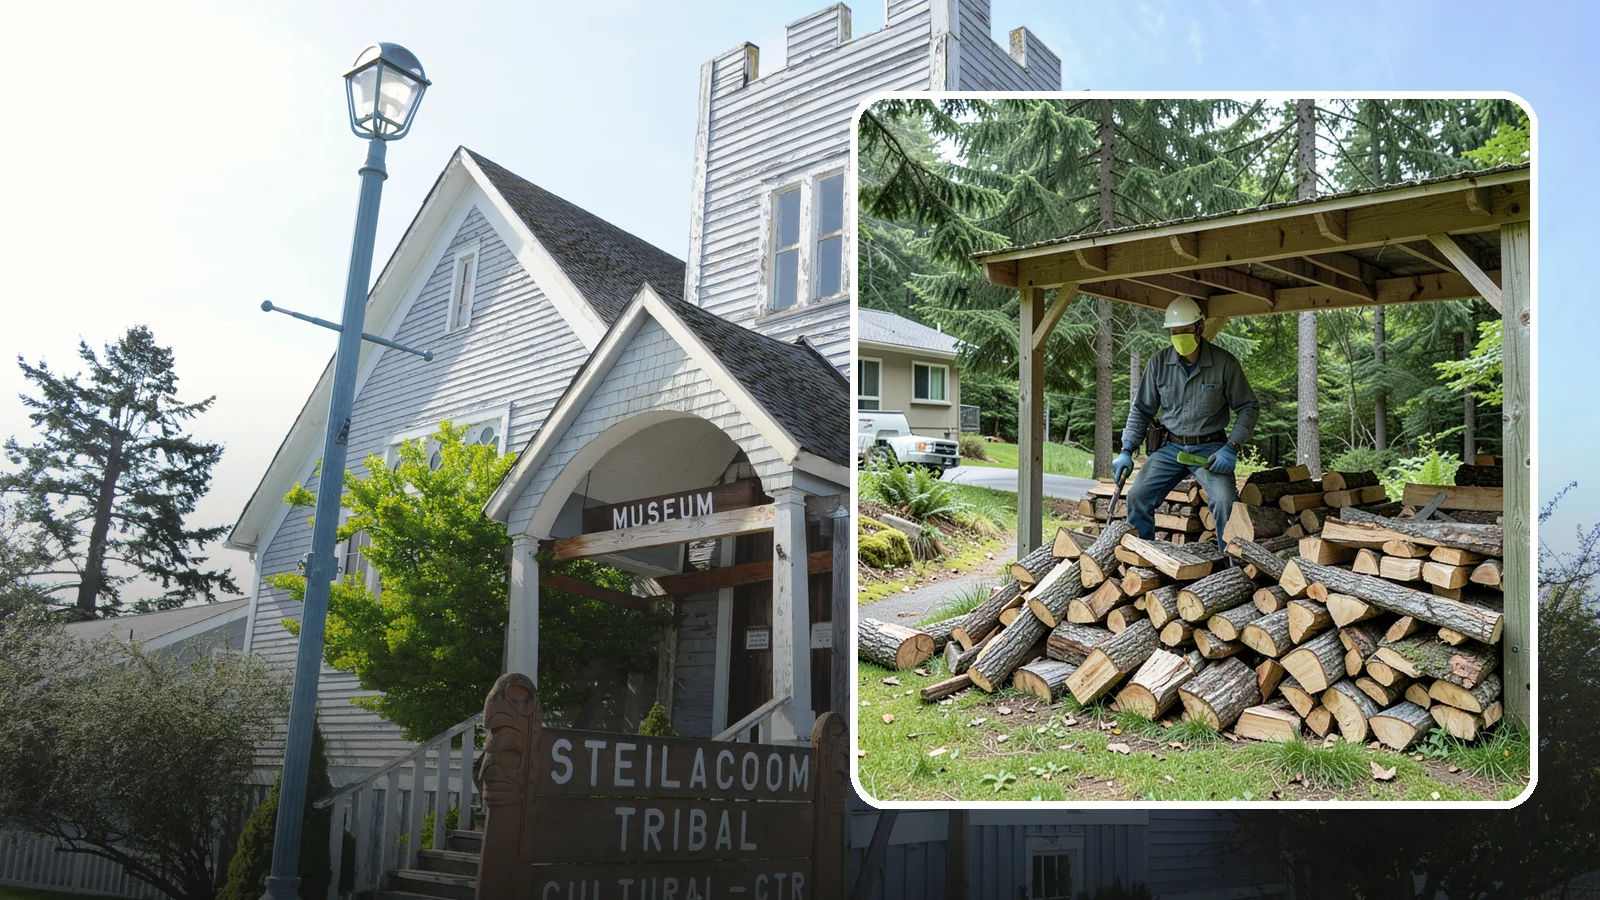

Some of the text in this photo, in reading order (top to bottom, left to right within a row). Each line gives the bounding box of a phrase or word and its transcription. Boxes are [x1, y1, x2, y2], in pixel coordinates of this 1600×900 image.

[612, 491, 713, 531] MUSEUM
[550, 738, 809, 793] STEILACOOM
[615, 806, 758, 852] TRIBAL
